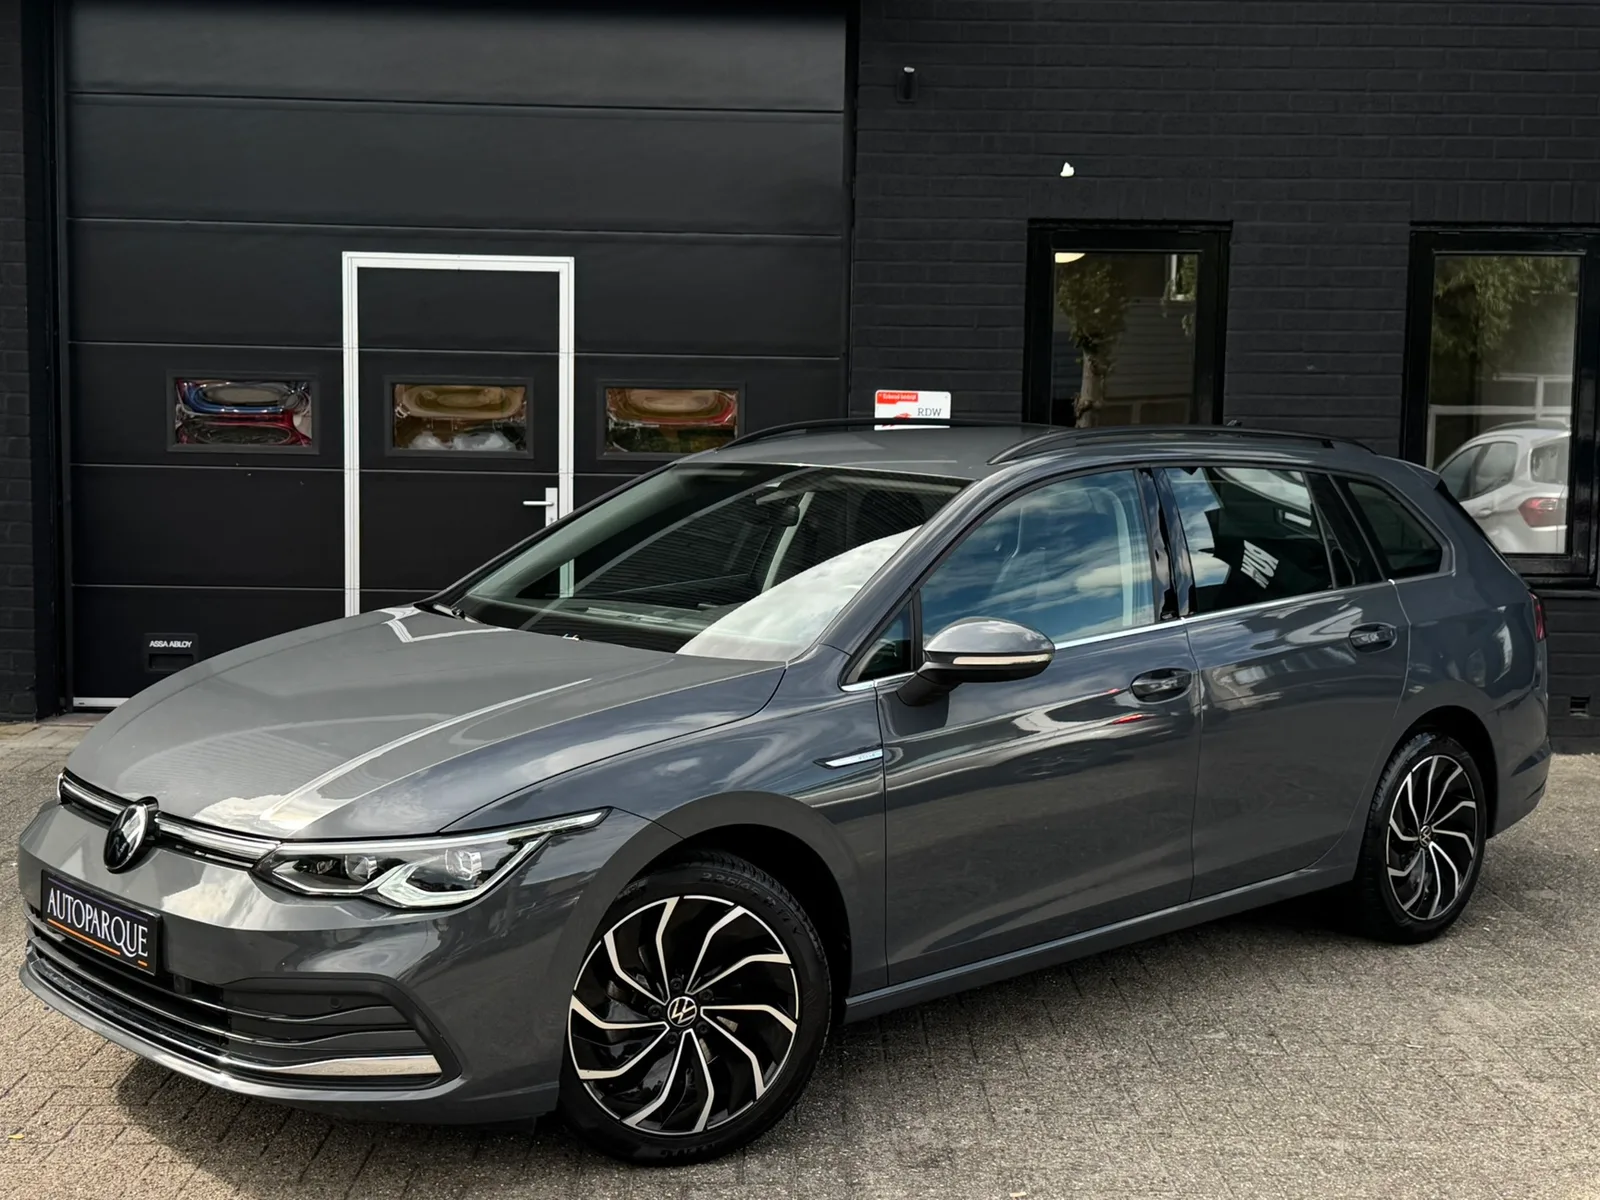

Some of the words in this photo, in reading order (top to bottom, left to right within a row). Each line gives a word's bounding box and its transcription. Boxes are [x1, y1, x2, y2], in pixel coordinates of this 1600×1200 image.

[917, 407, 942, 417] RDW
[149, 640, 169, 648] ASSA
[169, 640, 193, 648] ABLOY
[47, 887, 148, 957] AUTOPARQUE
